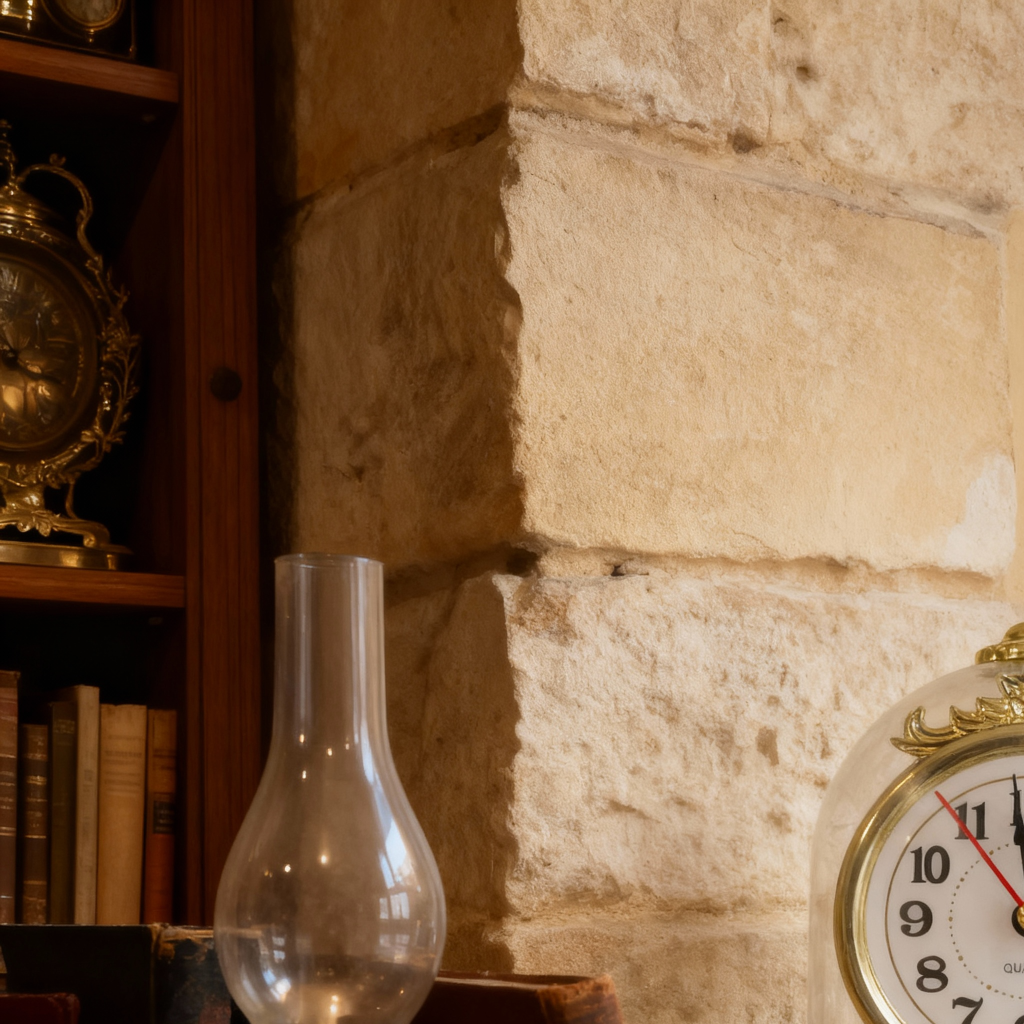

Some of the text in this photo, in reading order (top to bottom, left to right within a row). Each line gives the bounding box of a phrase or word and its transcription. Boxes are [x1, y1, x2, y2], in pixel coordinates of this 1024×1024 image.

[954, 801, 989, 840] 11
[910, 845, 950, 884] 10
[900, 900, 933, 938] 9
[916, 955, 949, 993] 8
